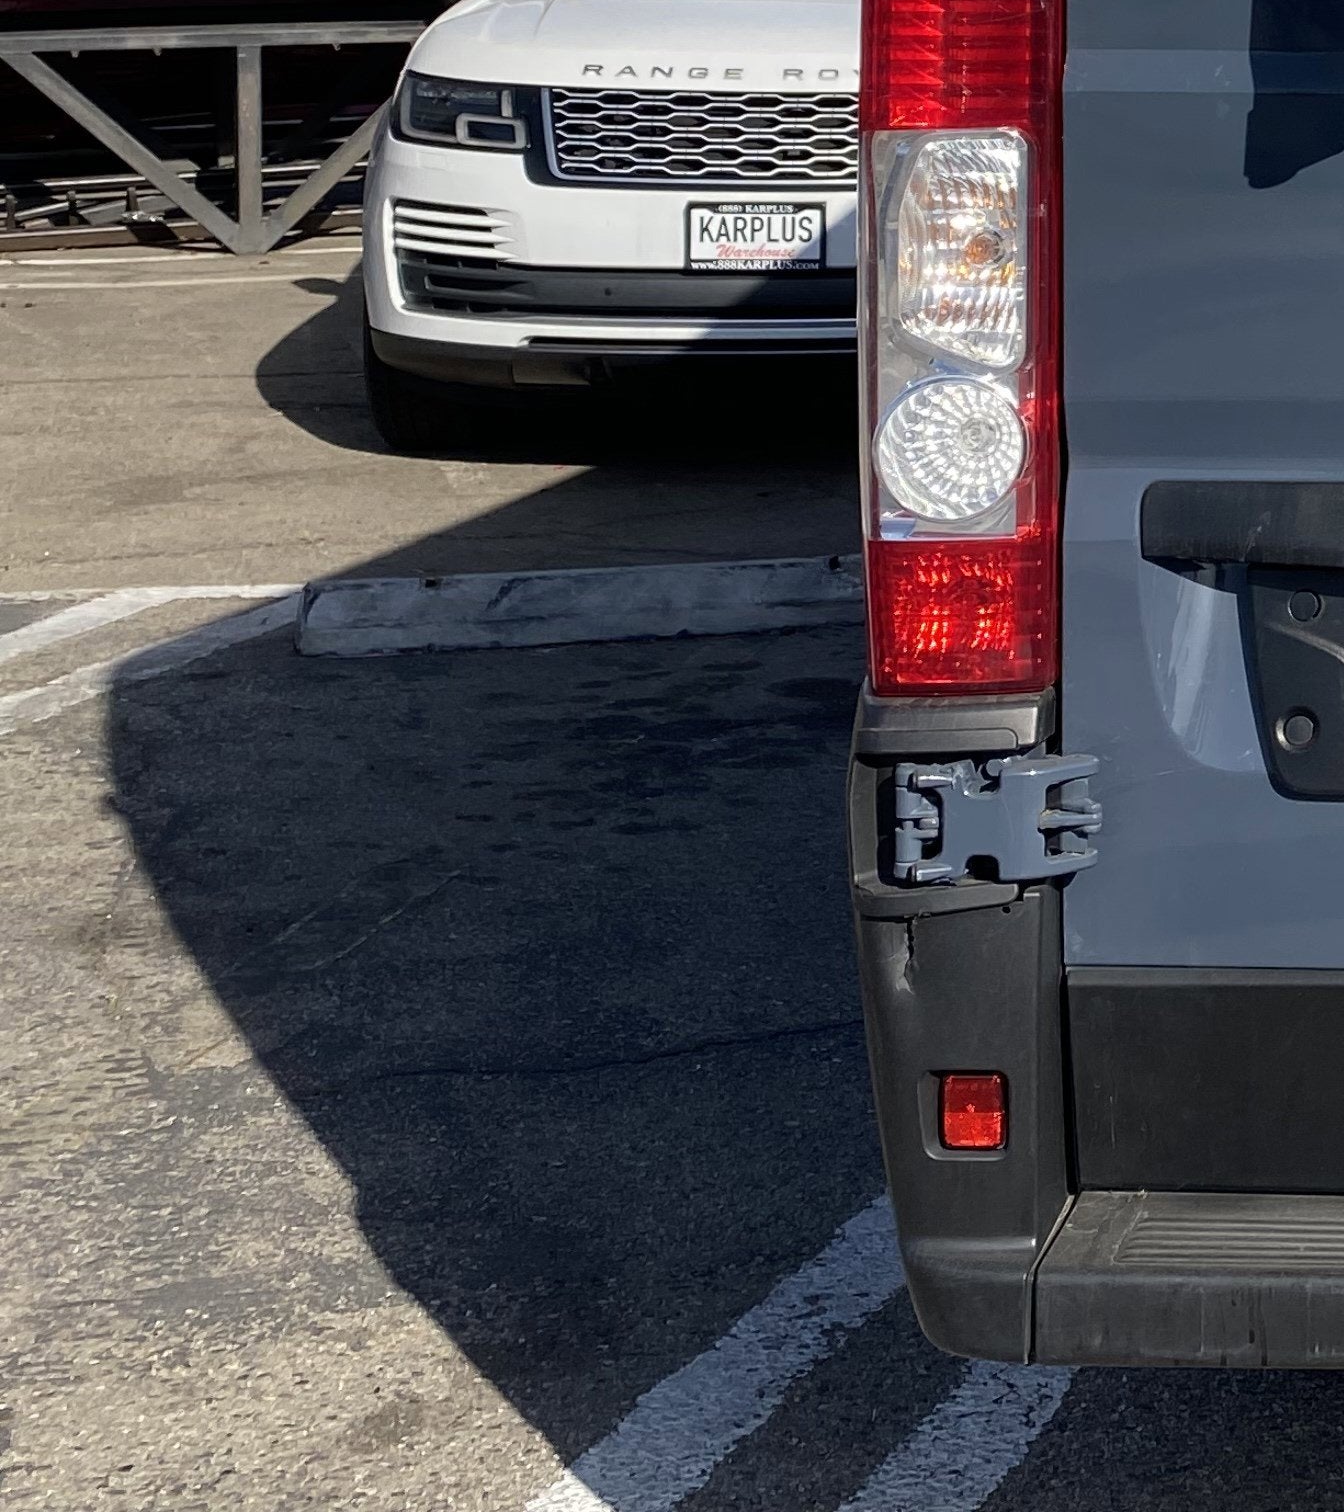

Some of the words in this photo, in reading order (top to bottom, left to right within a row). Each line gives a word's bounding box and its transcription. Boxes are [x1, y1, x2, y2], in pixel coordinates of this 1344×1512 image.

[581, 64, 744, 80] RANGE
[745, 204, 795, 214] KARPLUS
[699, 216, 813, 243] KARPLUS
[715, 242, 796, 258] Warehouse
